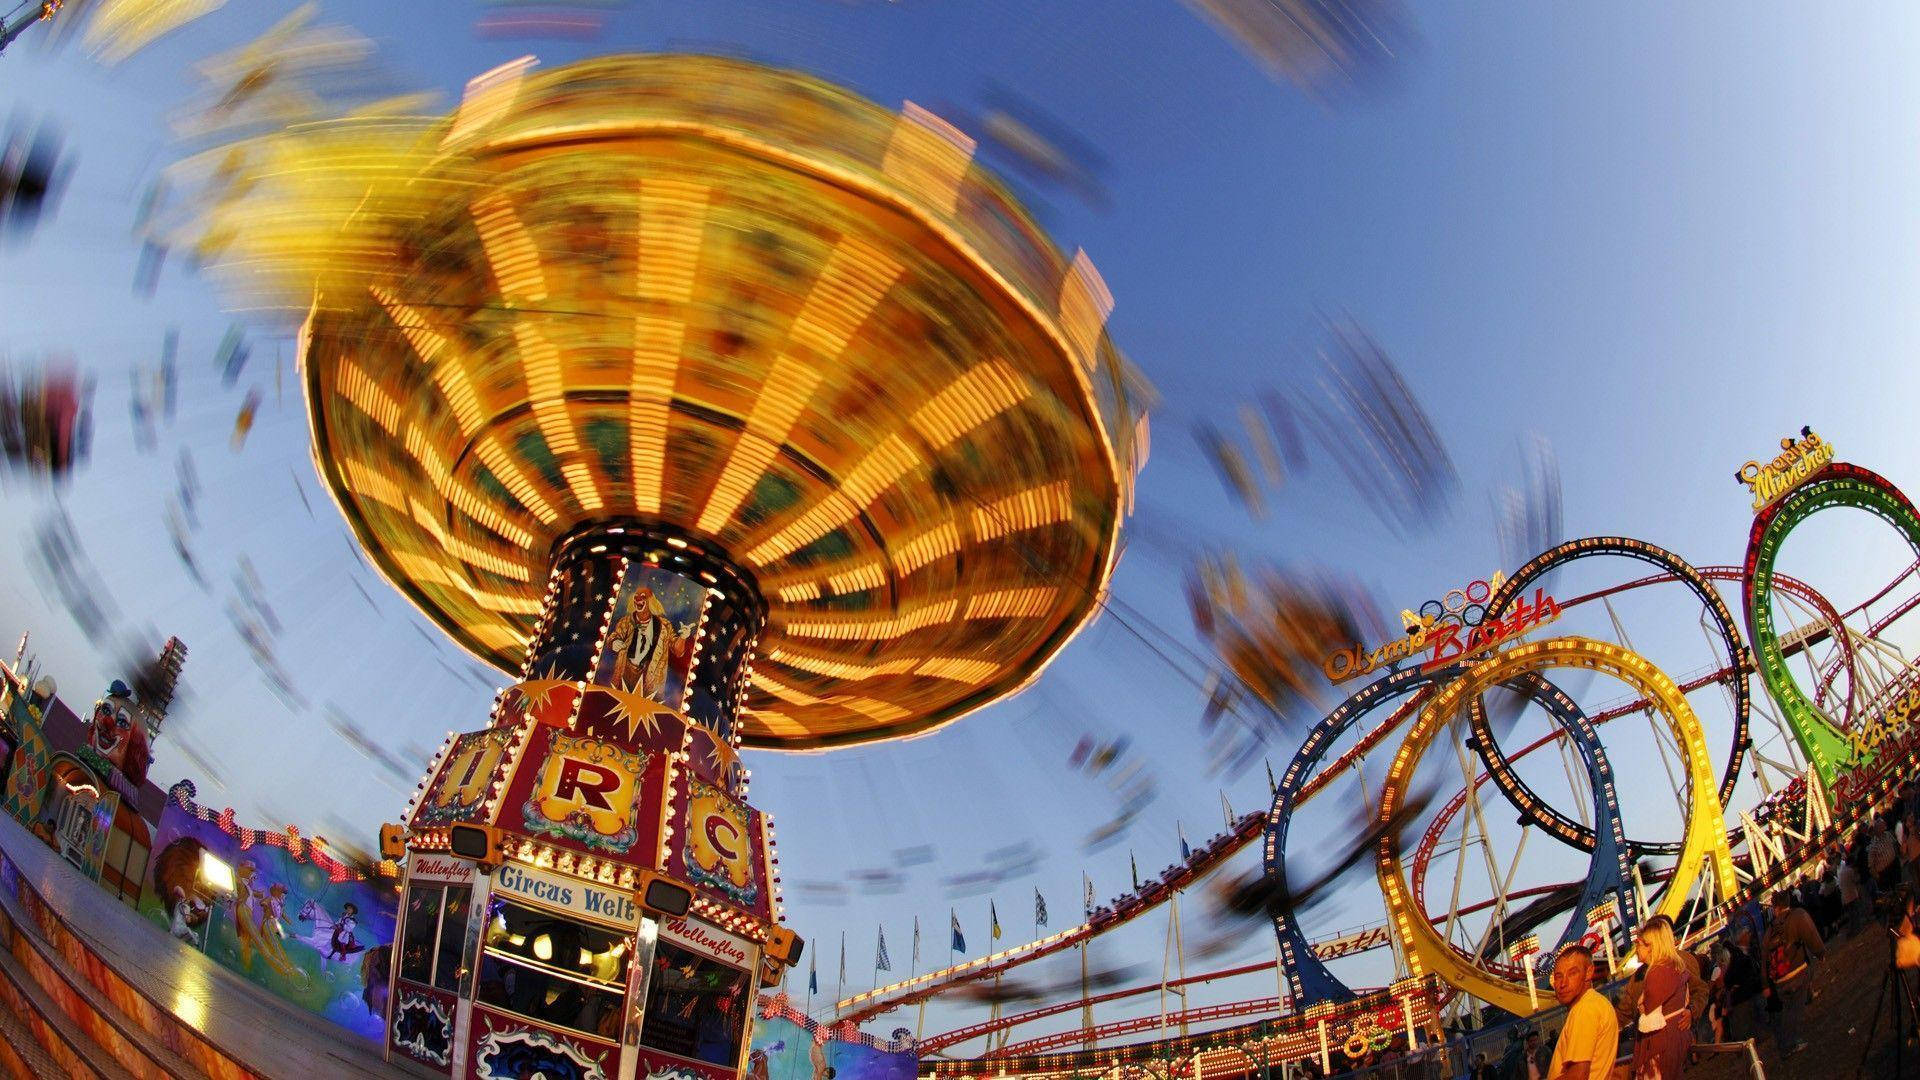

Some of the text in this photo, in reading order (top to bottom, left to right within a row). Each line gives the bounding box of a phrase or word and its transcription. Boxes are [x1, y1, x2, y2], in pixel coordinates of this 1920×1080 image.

[1421, 588, 1562, 672] Barth
[554, 757, 622, 812] R
[704, 814, 739, 861] C
[416, 858, 471, 885] Wellenflug
[499, 865, 635, 921] Circus Welt
[666, 918, 746, 963] Wellenflug
[1313, 928, 1391, 959] arth
